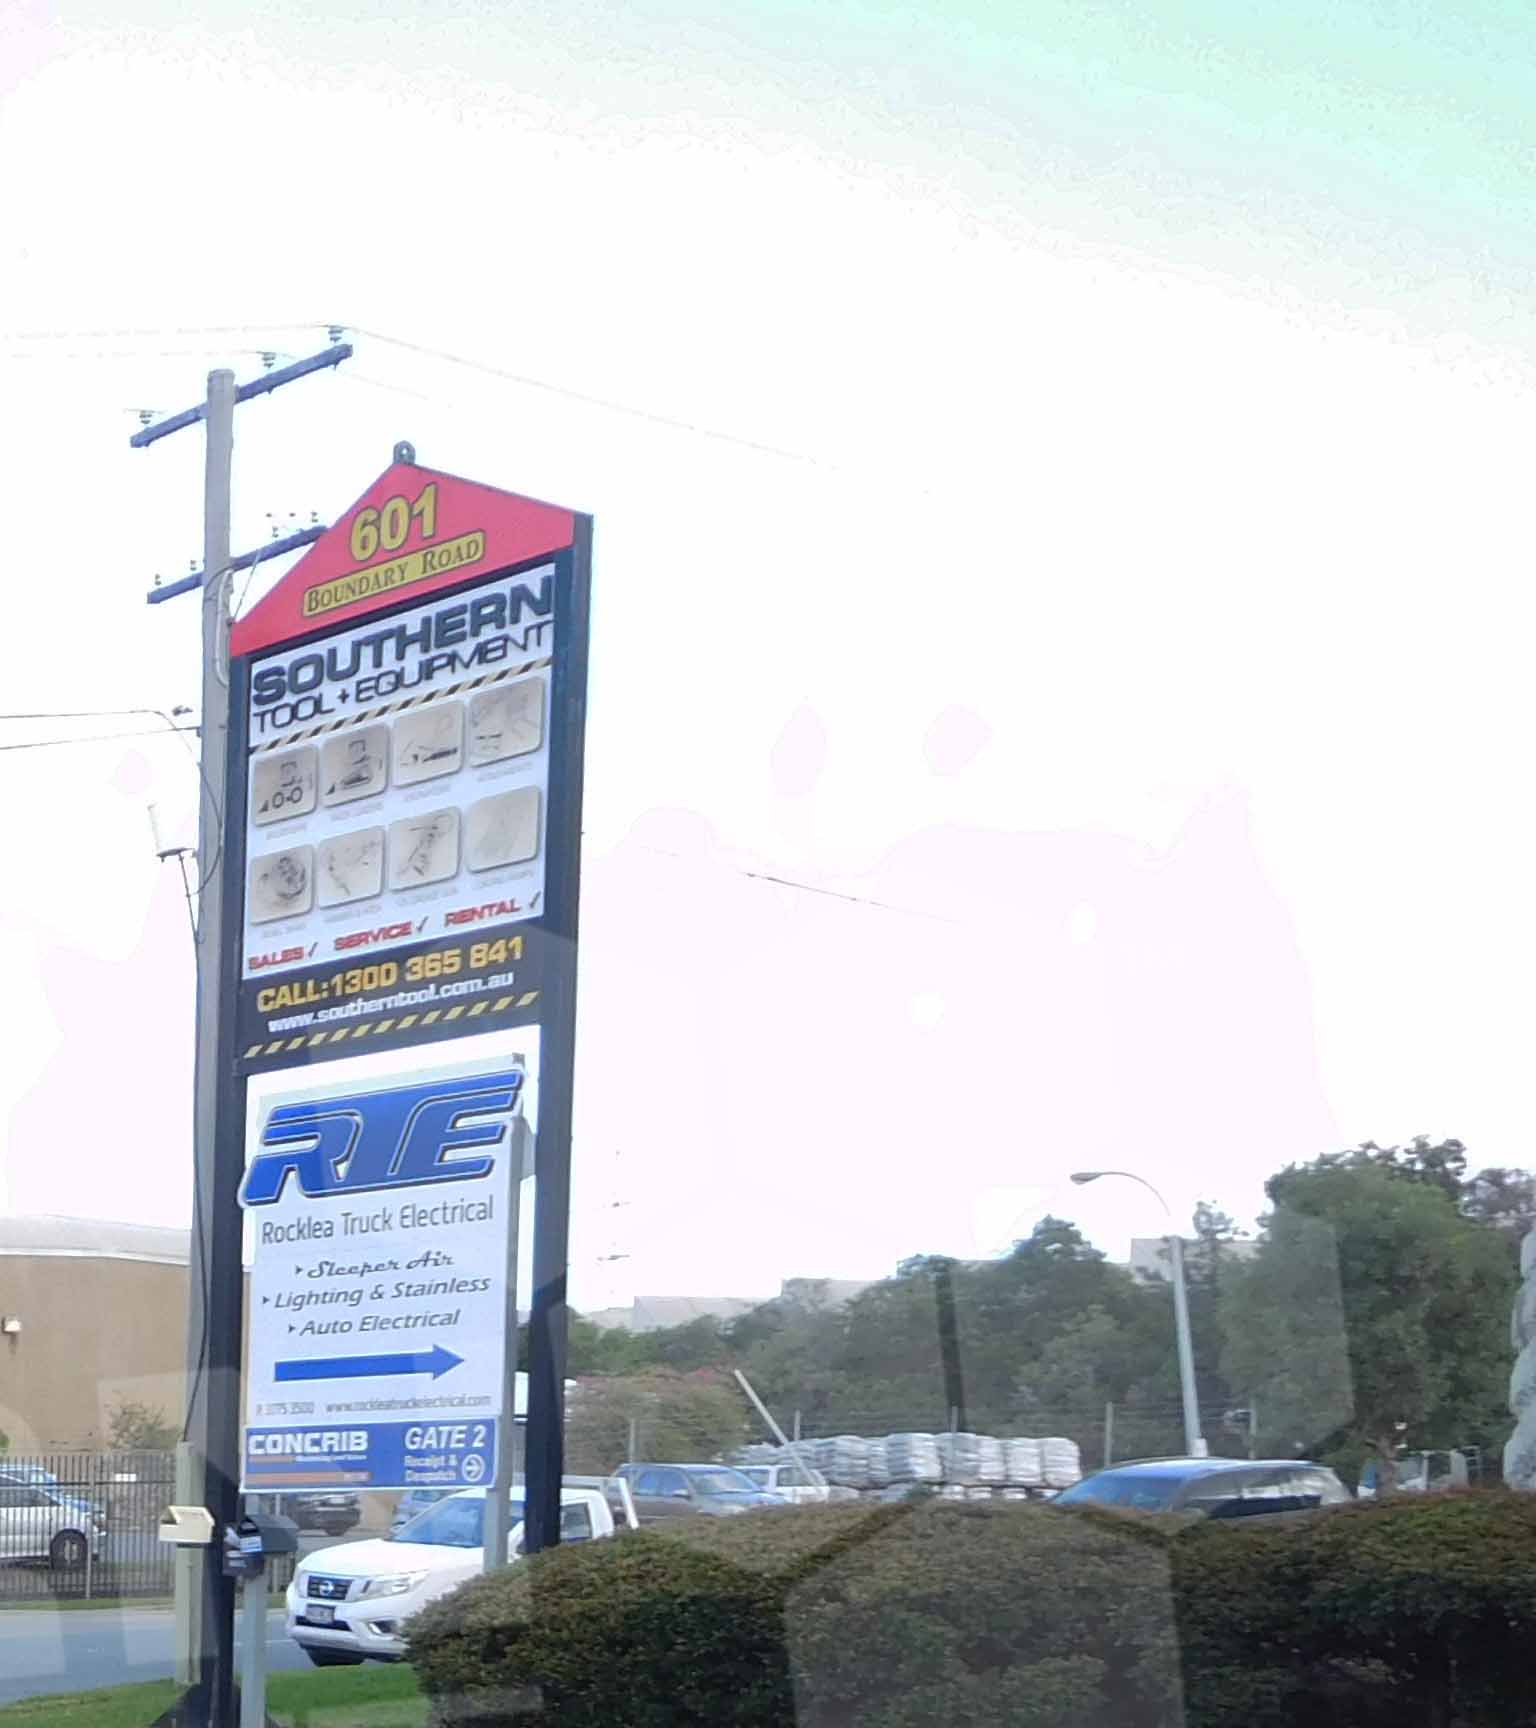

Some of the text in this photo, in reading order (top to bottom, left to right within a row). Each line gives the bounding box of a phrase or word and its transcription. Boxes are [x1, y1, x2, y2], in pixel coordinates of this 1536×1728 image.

[350, 482, 438, 562] 601
[307, 539, 481, 613] BOUNDARY ROAD
[251, 574, 553, 707] SOUTHERN
[253, 691, 335, 734] TOOL
[355, 620, 554, 702] EQUIPMENT
[249, 946, 304, 970] SALES
[334, 921, 413, 951] SERVICE
[444, 899, 521, 927] RENTAL
[405, 948, 461, 983] 365
[469, 935, 524, 968] 841
[268, 972, 514, 1032] www.southerntool.com.au
[239, 1069, 523, 1206] RTE
[262, 1195, 494, 1245] Rocklea Truck Electrical
[274, 1275, 491, 1312] Lighting & Stainless
[306, 1251, 456, 1280] Sleeper Air
[298, 1309, 461, 1337] Auto Electrical
[247, 1425, 487, 1455] CONCRIB GATE 2
